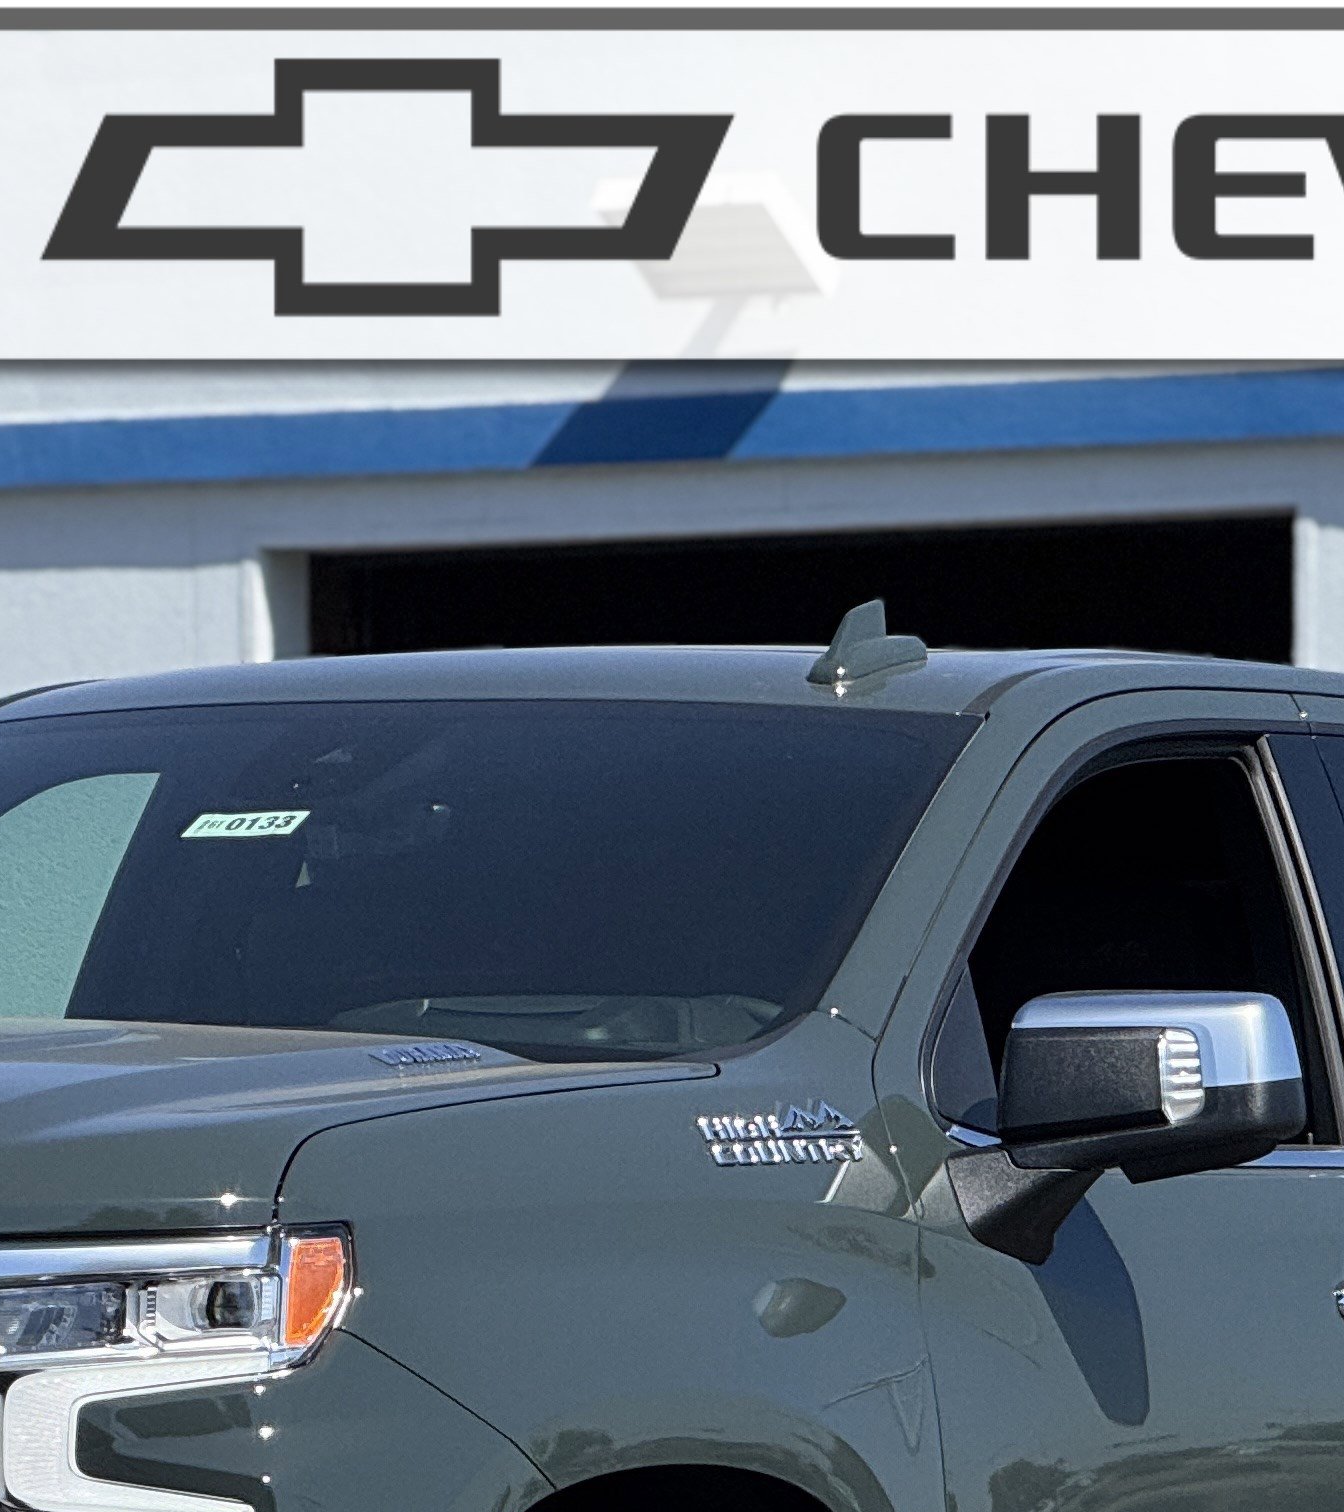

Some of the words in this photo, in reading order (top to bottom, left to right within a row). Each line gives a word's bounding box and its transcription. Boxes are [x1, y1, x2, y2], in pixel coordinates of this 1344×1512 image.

[226, 815, 297, 830] 0133
[697, 1115, 782, 1141] HIGH
[711, 1136, 863, 1166] COUNTRY
